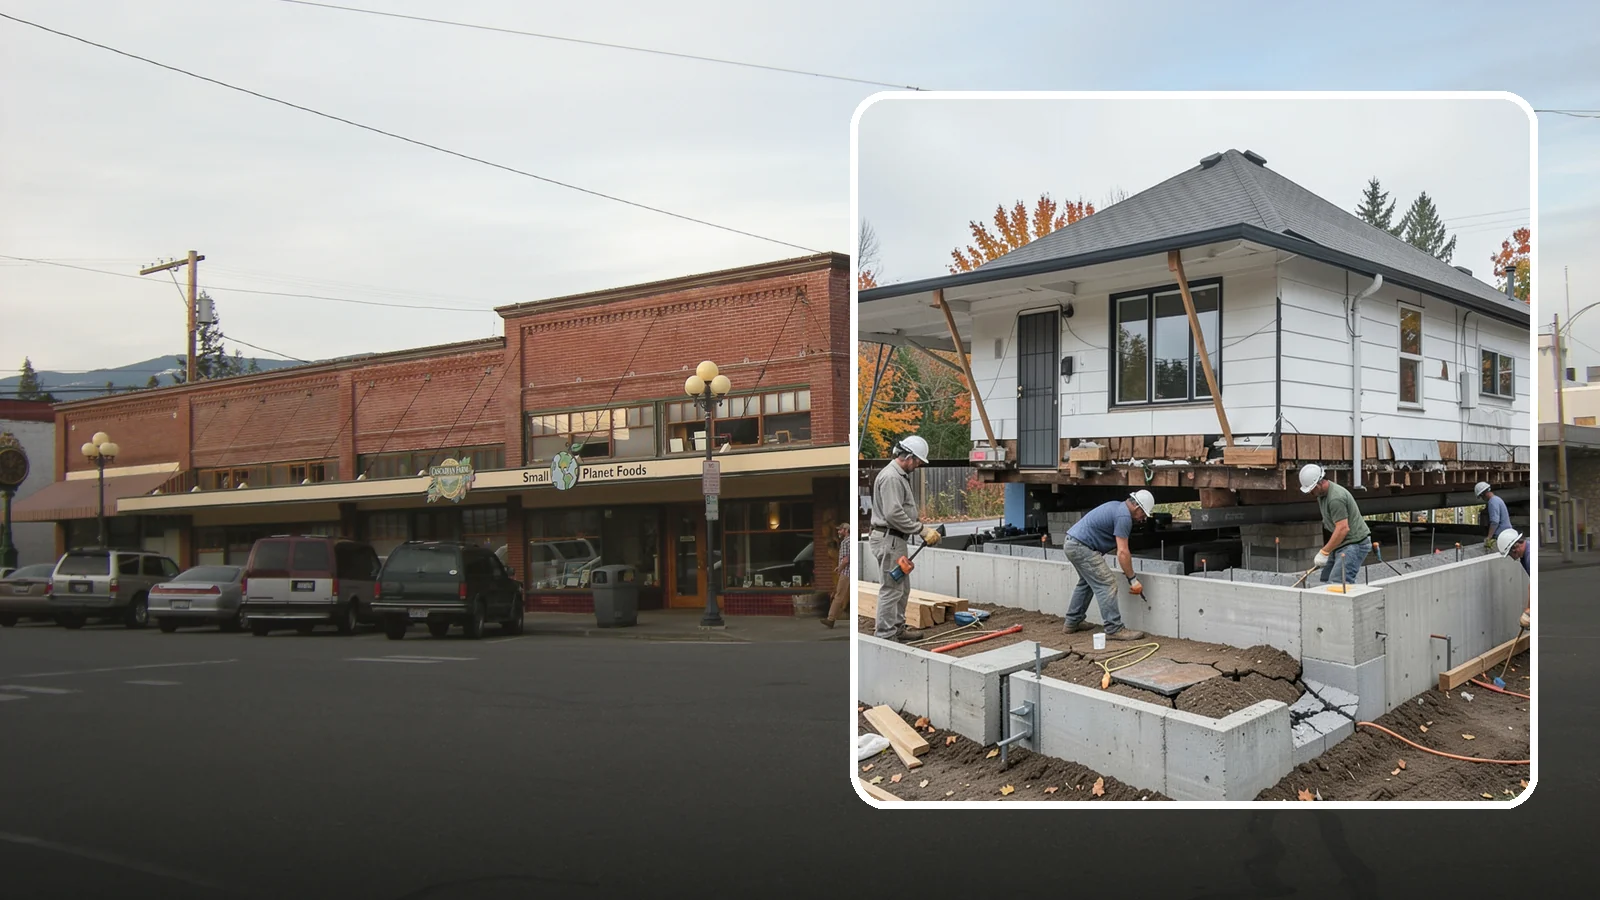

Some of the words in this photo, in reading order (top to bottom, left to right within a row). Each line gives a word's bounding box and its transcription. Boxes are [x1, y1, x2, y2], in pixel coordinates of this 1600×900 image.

[523, 471, 549, 483] Small
[583, 467, 614, 479] Planet
[617, 464, 647, 477] Foods
